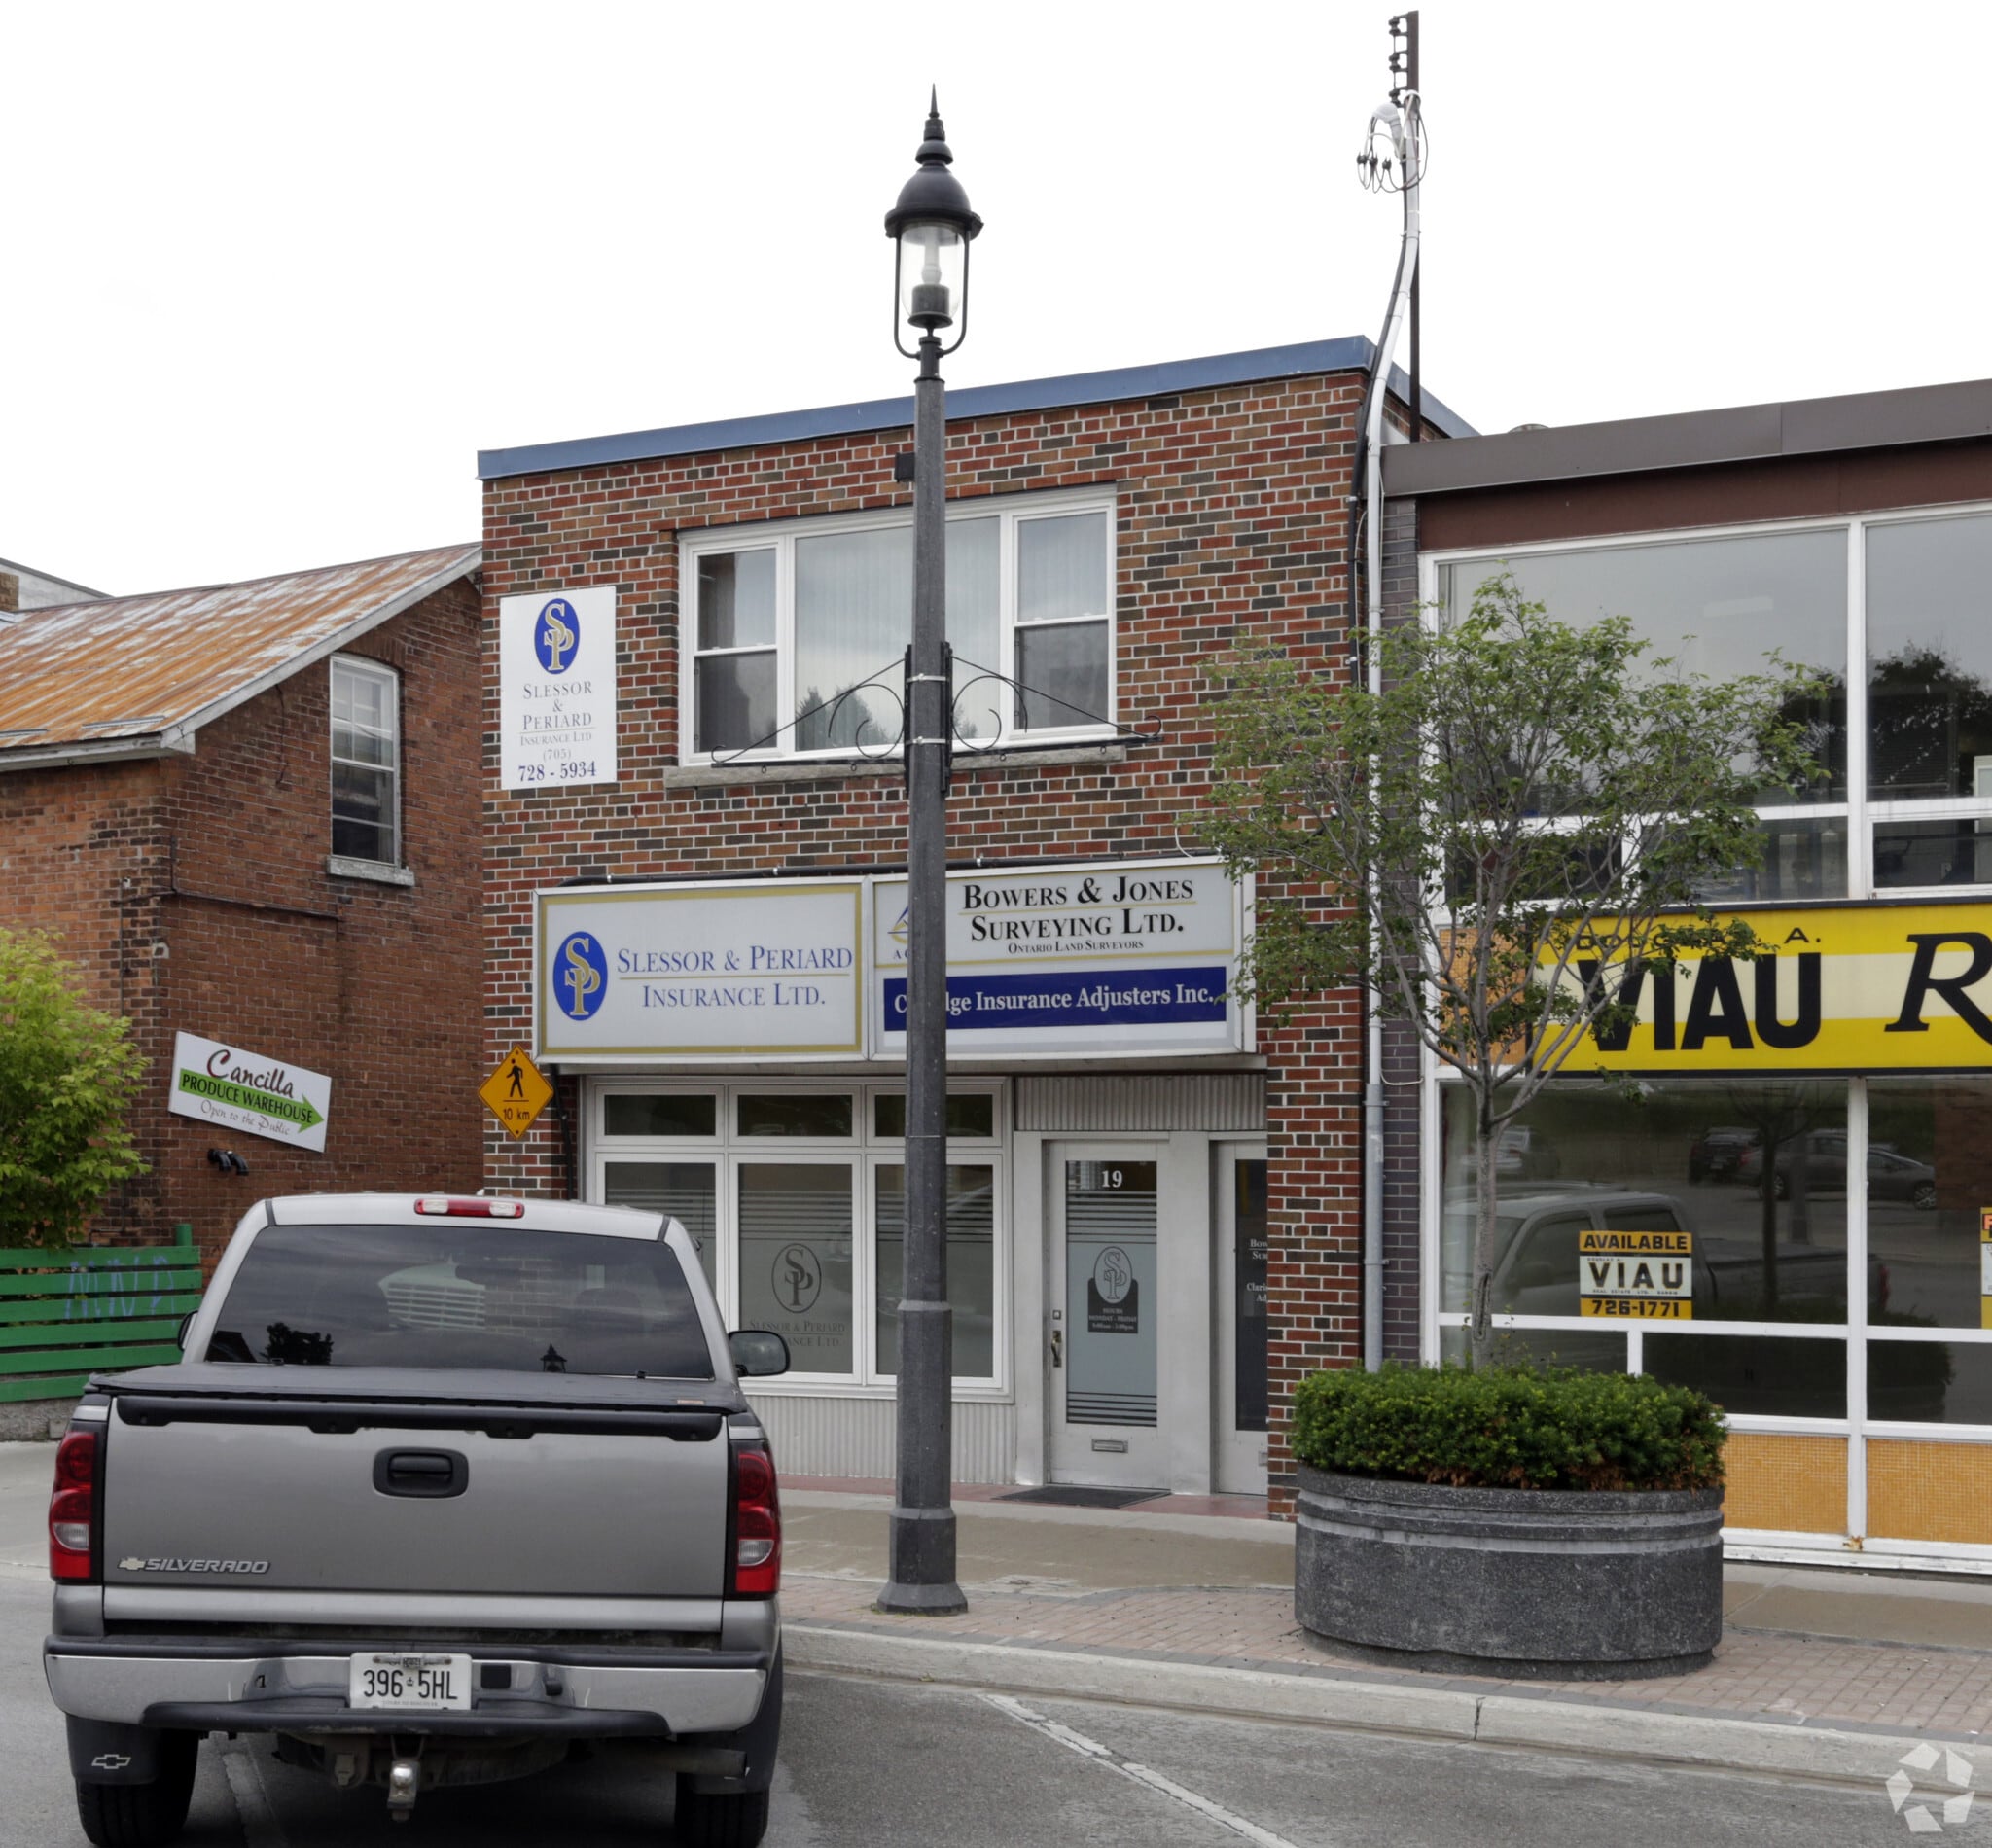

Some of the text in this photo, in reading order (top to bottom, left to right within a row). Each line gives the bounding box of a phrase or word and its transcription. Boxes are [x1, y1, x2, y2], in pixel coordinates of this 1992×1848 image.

[523, 680, 592, 699] SLESSOR
[552, 698, 563, 712] &
[523, 712, 592, 730] PERIARD
[519, 732, 570, 747] INSURANCE
[543, 748, 571, 762] (705)
[518, 764, 545, 782] 728
[560, 760, 597, 779] 5934
[963, 875, 1193, 909] BOWERS & JONES
[971, 908, 1185, 942] SURVEYING LTD.
[1784, 927, 1822, 943] A.
[1008, 939, 1144, 954] ONTARIO LAND SURVEYORS
[617, 945, 853, 973] SLESSOR & PERIARD
[643, 983, 826, 1008] INSURANCE LTD.
[976, 990, 1072, 1010] Insurance
[1076, 985, 1171, 1013] Adjusters
[1176, 983, 1214, 1004] Inc.
[1577, 952, 1822, 1051] VIAU
[207, 1049, 294, 1099] Cancilla
[182, 1074, 312, 1123] PRODUCE WAREHOUSE
[201, 1100, 290, 1135] Open to the Public
[503, 1108, 530, 1120] 10 km
[1101, 1170, 1123, 1188] 19
[1584, 1235, 1687, 1250] AVAILABLE
[1588, 1262, 1683, 1289] VIAU
[1592, 1300, 1679, 1317] 726-1771
[146, 1558, 269, 1574] SILVERADO
[363, 1669, 458, 1700] 396 5HL
